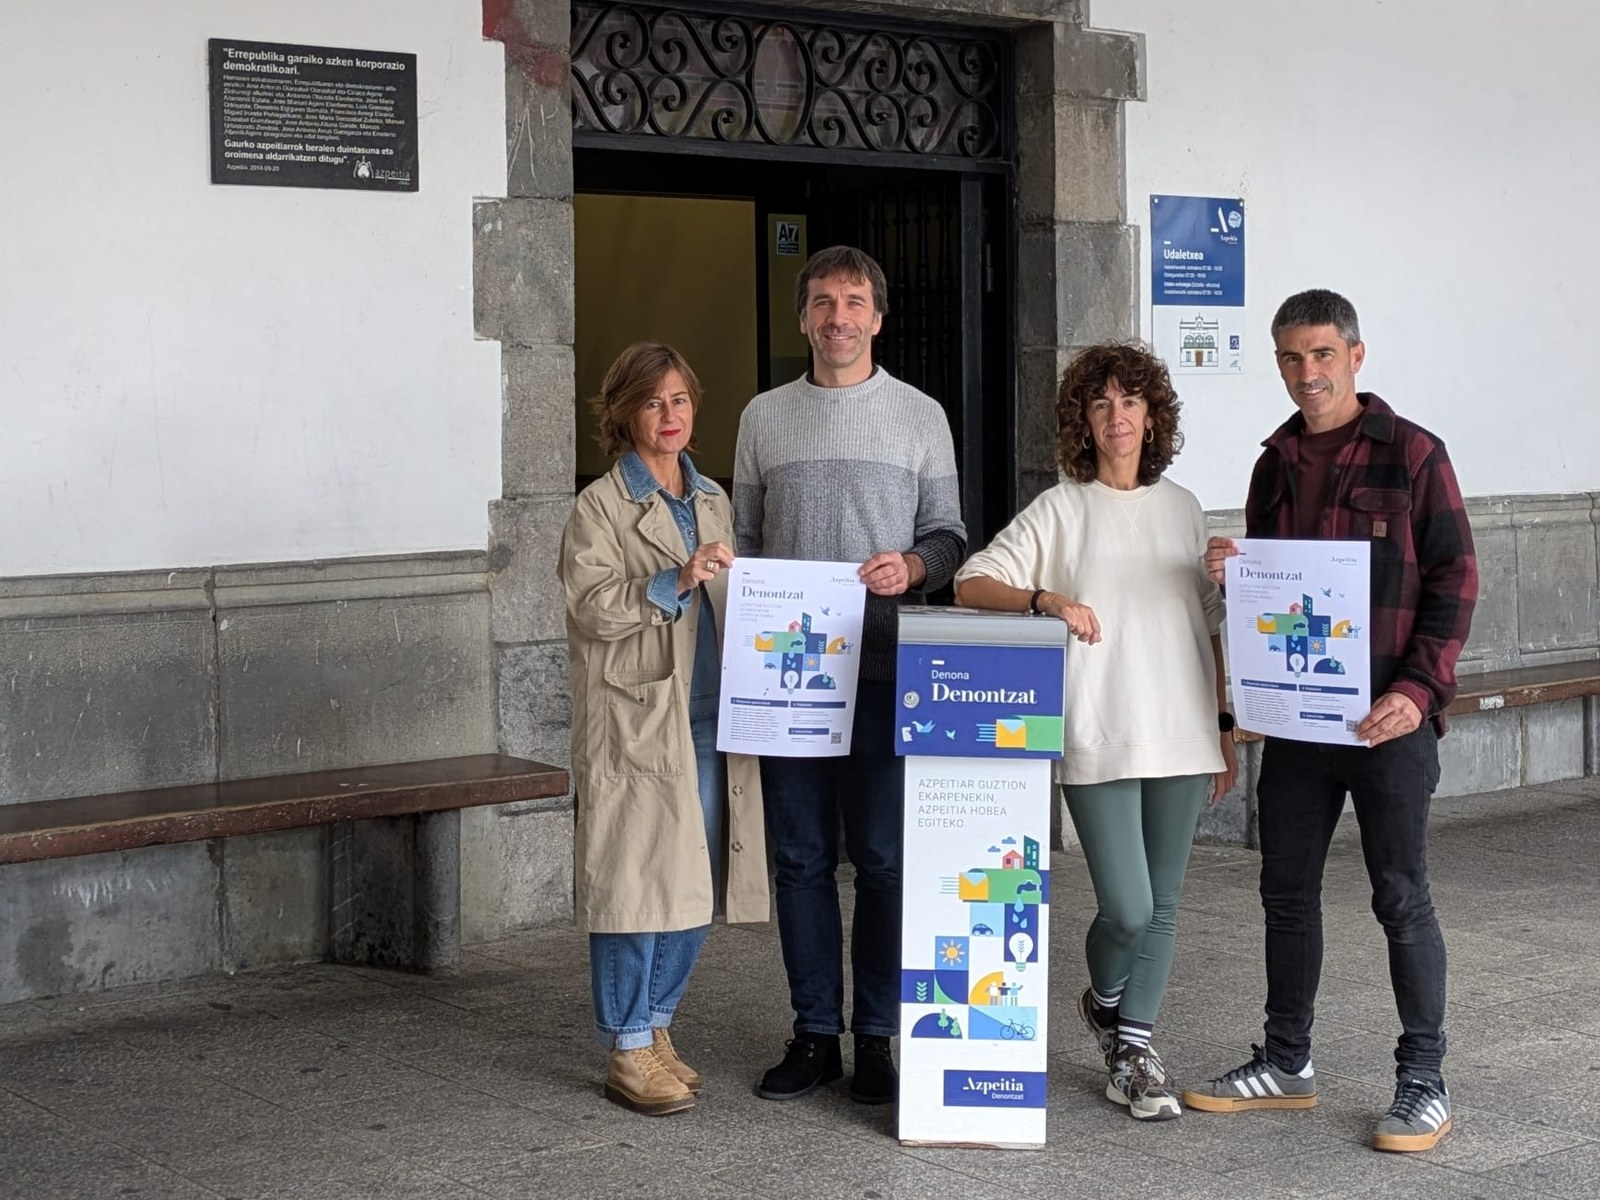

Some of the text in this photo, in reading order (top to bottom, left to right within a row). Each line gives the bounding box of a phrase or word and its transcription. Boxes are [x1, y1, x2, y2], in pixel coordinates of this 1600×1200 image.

[223, 61, 300, 75] demokratikoari.
[287, 52, 324, 65] garaiko
[325, 56, 354, 67] azken
[355, 57, 406, 71] korporazio
[224, 139, 255, 149] Gaurko
[256, 141, 304, 152] azpeitiarrok
[336, 144, 380, 155] duintasuna
[381, 147, 394, 155] eta
[224, 150, 264, 160] oroimena
[265, 152, 317, 163] aldarrikatzen
[374, 168, 411, 183] azpeitia
[779, 223, 799, 243] A7
[1164, 248, 1204, 260] Udaletxea
[1239, 566, 1303, 581] Denontzat
[741, 585, 804, 600] Denontzat
[931, 669, 970, 680] Denona
[931, 682, 1038, 704] Denontzat
[918, 778, 1027, 790] AZPEITIAR GUZTION
[918, 792, 998, 804] EKARPENEKIN,
[918, 805, 1007, 816] AZPEITIA HOBEA
[918, 818, 967, 828] EGITEKO.
[963, 1077, 1024, 1094] Azpeitia
[991, 1093, 1024, 1101] Denontzat
